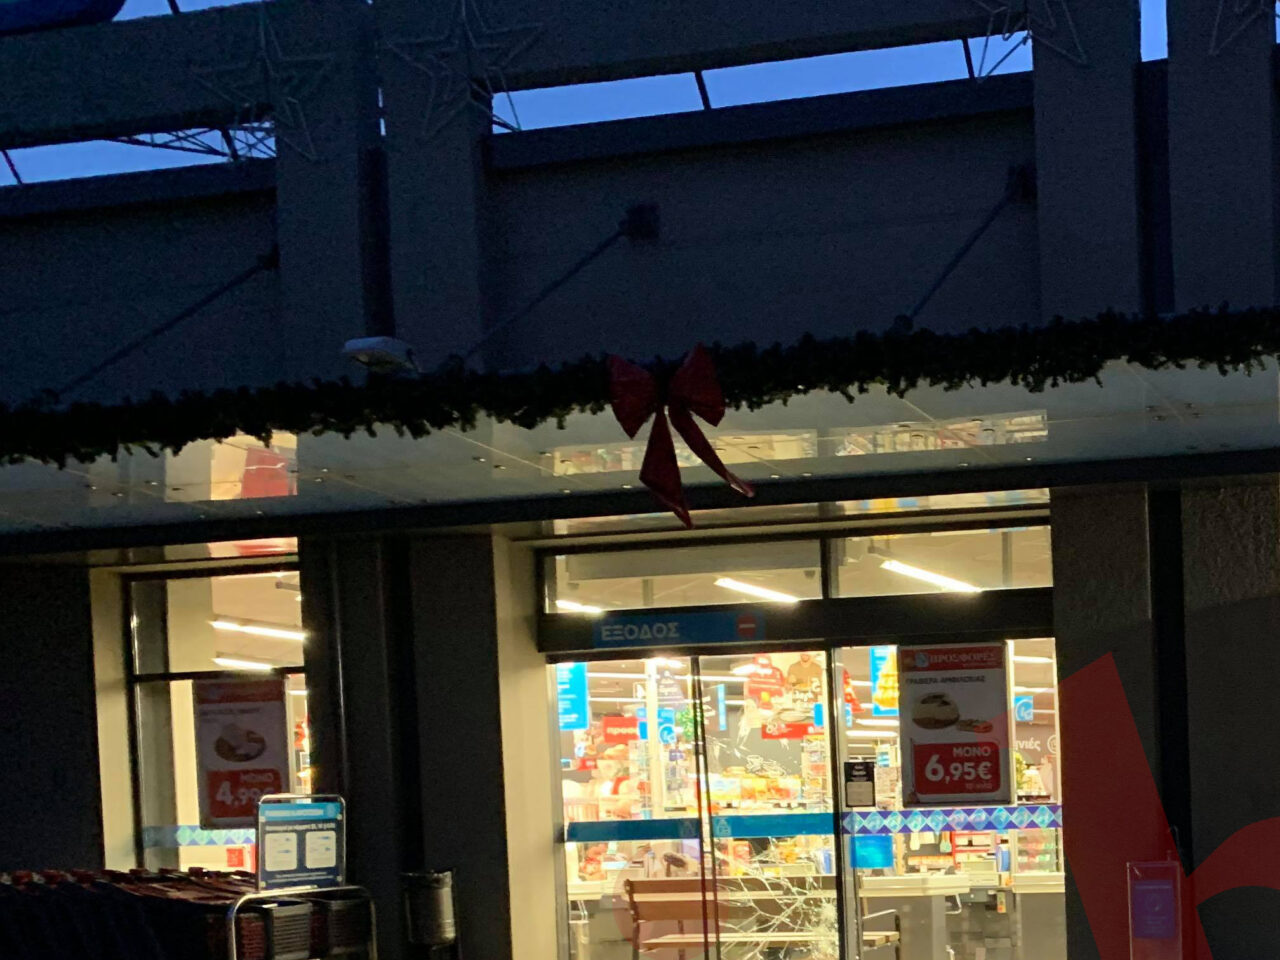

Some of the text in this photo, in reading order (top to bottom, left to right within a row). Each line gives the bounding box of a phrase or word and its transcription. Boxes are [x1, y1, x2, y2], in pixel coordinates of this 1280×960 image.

[601, 621, 681, 642] ΕΞΟΔΟΣ
[952, 746, 991, 757] ΜΟΝΟ
[924, 754, 993, 784] 6,95€
